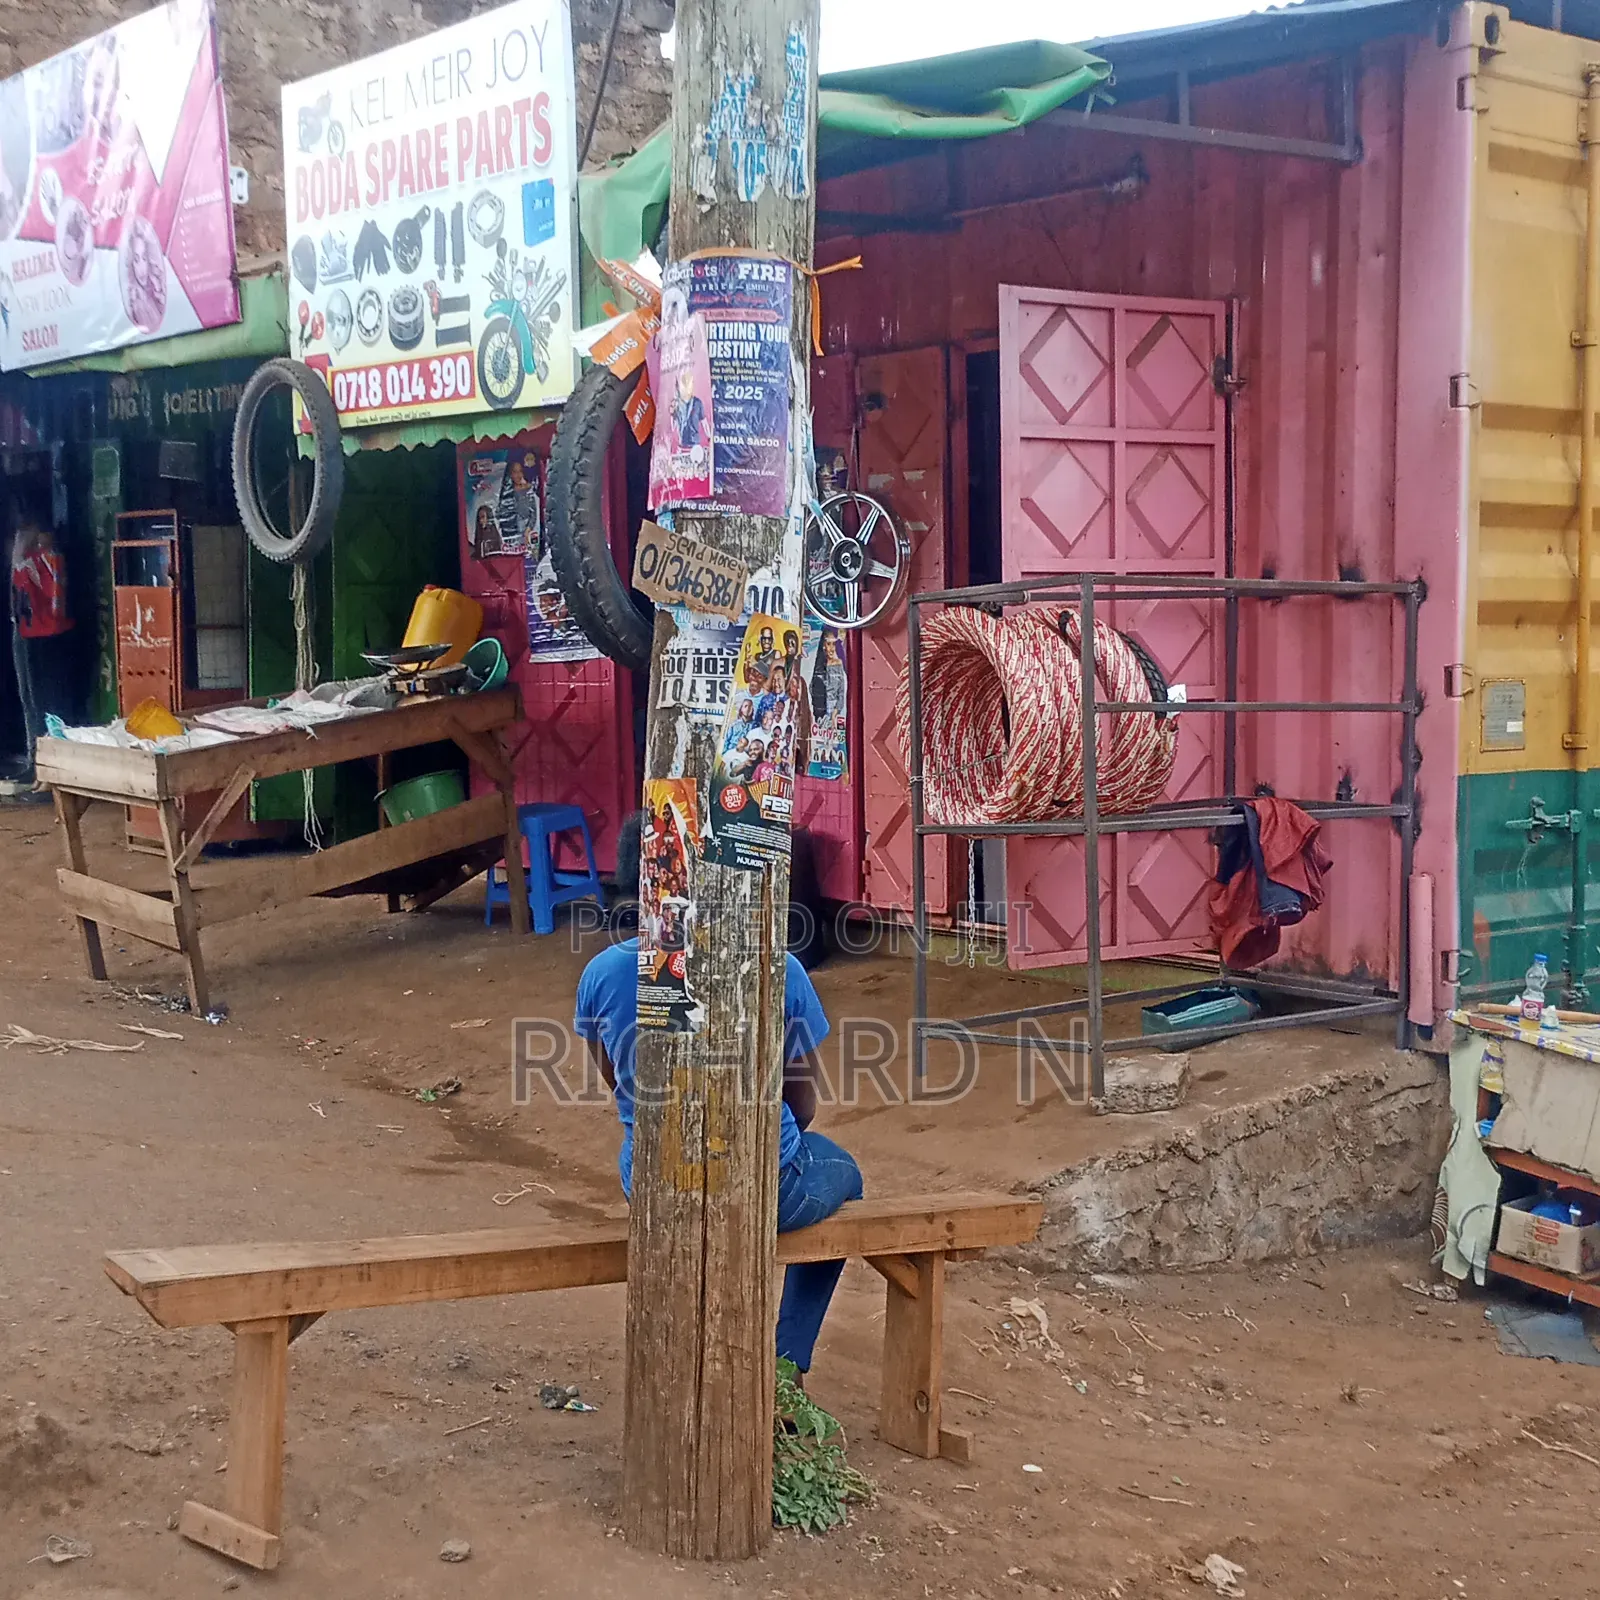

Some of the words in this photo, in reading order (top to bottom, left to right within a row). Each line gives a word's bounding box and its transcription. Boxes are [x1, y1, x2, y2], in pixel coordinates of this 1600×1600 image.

[350, 76, 393, 132] KEL
[405, 47, 472, 114] MEIR
[486, 19, 549, 90] JOY
[296, 150, 360, 223] BODA
[365, 121, 450, 207] SPARE
[456, 90, 553, 183] PARTS
[738, 262, 786, 284] FIRE
[22, 324, 59, 352] SALON
[758, 323, 790, 344] YOUR
[708, 340, 762, 360] DESTINY
[334, 365, 382, 411] 0718
[385, 361, 426, 404] 014
[429, 355, 472, 397] 390
[724, 385, 764, 401] 2025
[713, 435, 745, 446] DAIMA
[698, 500, 742, 512] welcome
[811, 723, 833, 741] Curly
[726, 800, 741, 809] OCT
